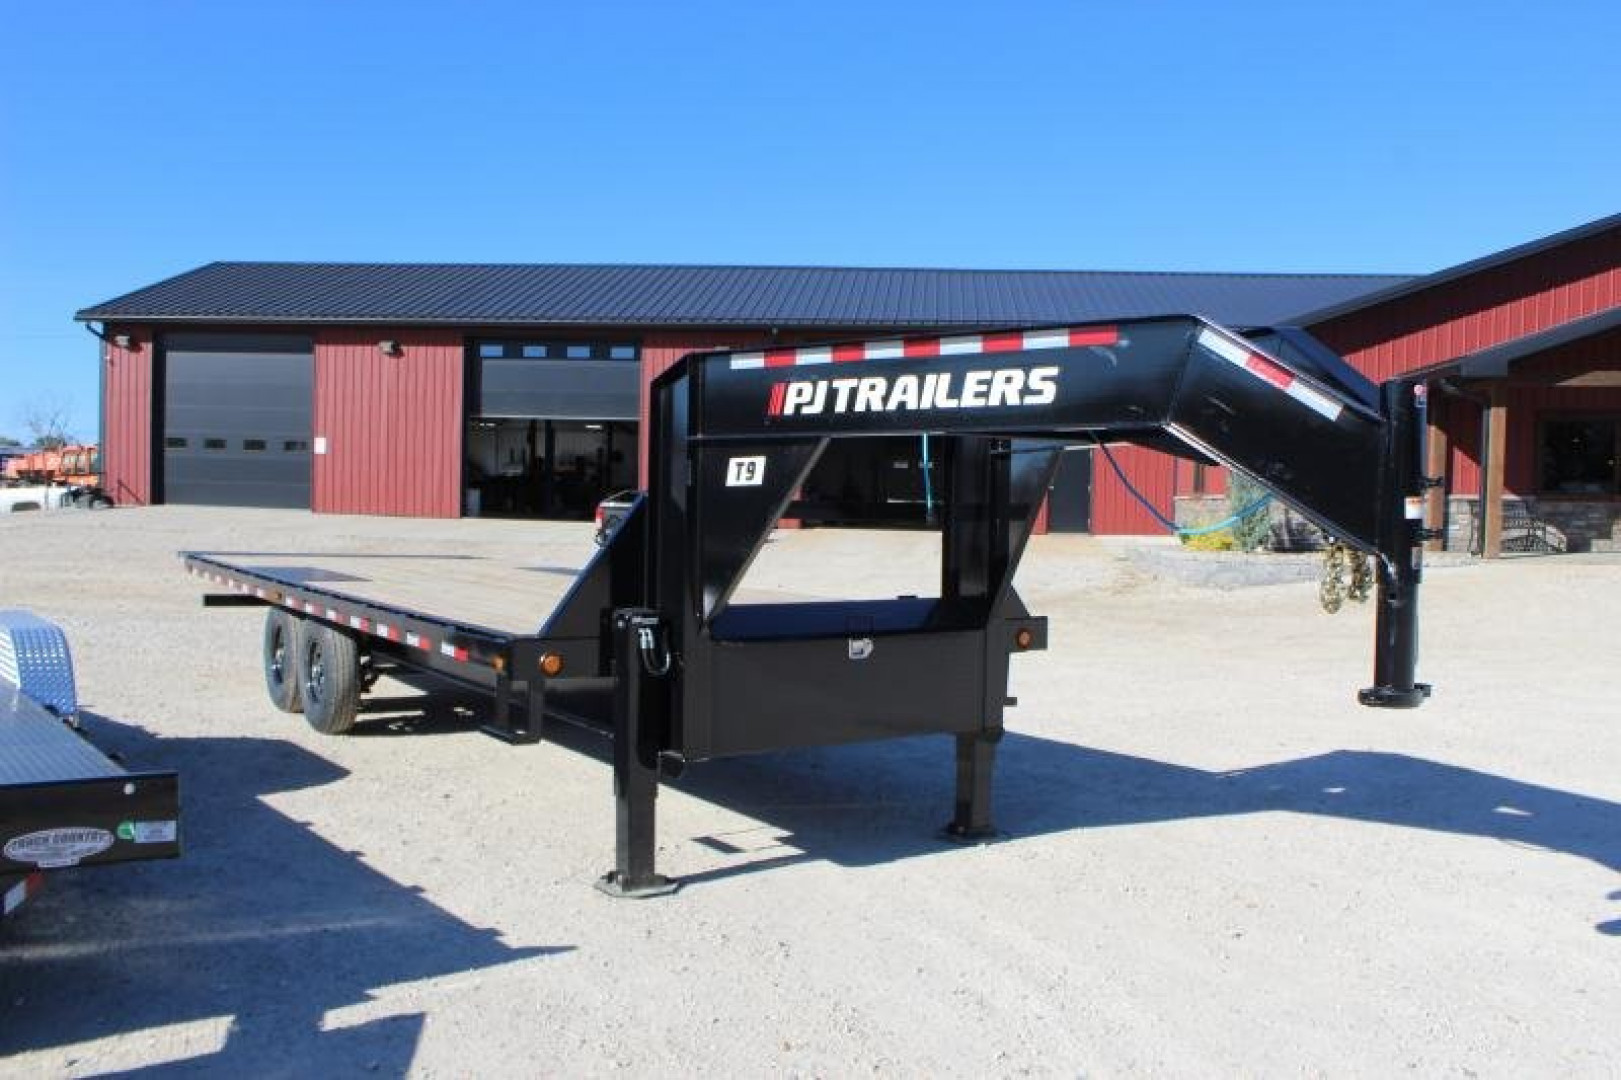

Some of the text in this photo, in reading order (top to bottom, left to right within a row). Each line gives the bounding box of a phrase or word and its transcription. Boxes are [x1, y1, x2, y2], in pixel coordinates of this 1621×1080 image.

[783, 366, 1059, 415] PJ TRAILERS
[735, 461, 757, 481] T9
